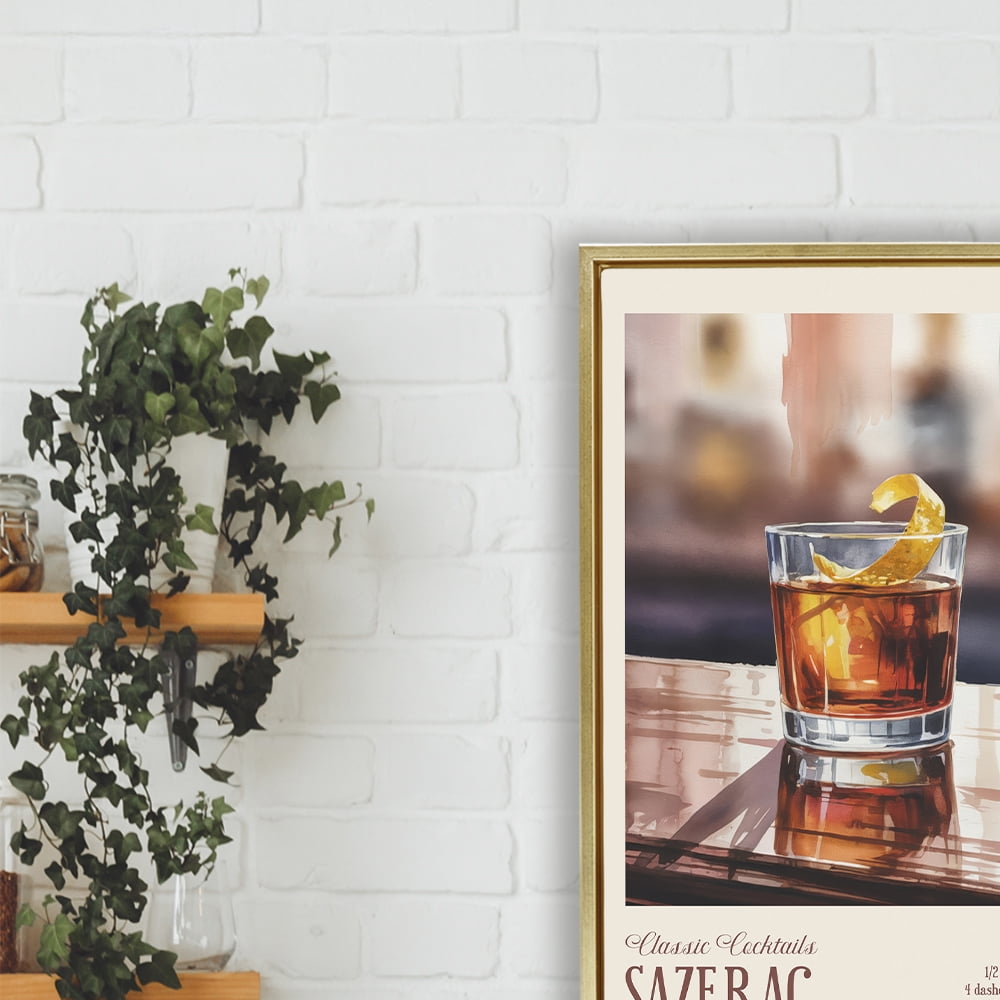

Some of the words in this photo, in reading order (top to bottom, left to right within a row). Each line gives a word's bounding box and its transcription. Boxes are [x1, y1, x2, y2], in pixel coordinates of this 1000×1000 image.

[625, 931, 711, 956] Classic
[716, 931, 818, 956] Cocktails
[985, 966, 998, 980] 1/2
[965, 984, 970, 995] 4
